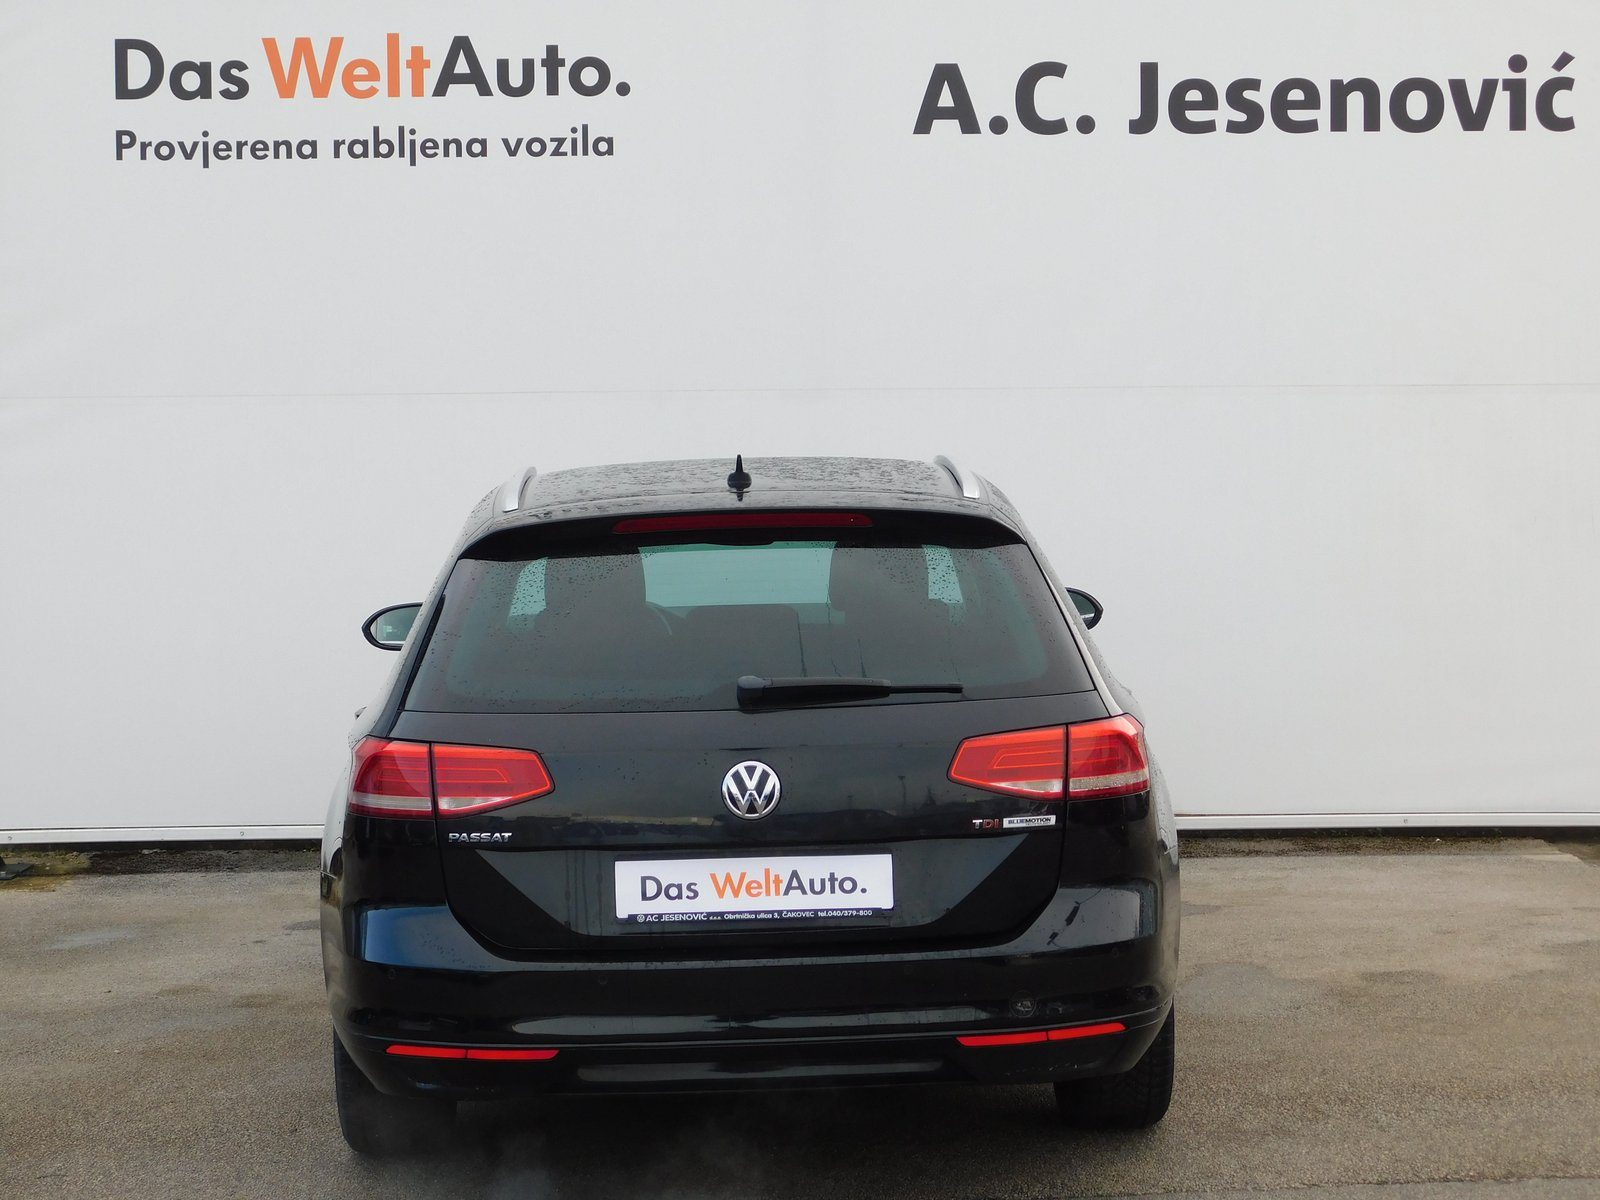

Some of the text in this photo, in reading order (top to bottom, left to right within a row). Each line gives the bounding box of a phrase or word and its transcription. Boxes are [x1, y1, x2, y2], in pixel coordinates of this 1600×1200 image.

[114, 33, 631, 101] Das WeltAuto.
[912, 51, 1576, 136] A.C. Jesenović
[115, 124, 615, 169] Provjerena rabljena vozila
[448, 832, 512, 842] PASSAT
[972, 819, 1000, 829] TDI
[640, 868, 867, 901] Das WeltAuto.
[645, 914, 659, 922] AC
[660, 913, 708, 921] JESENOVIĆ
[773, 912, 780, 920] 3,
